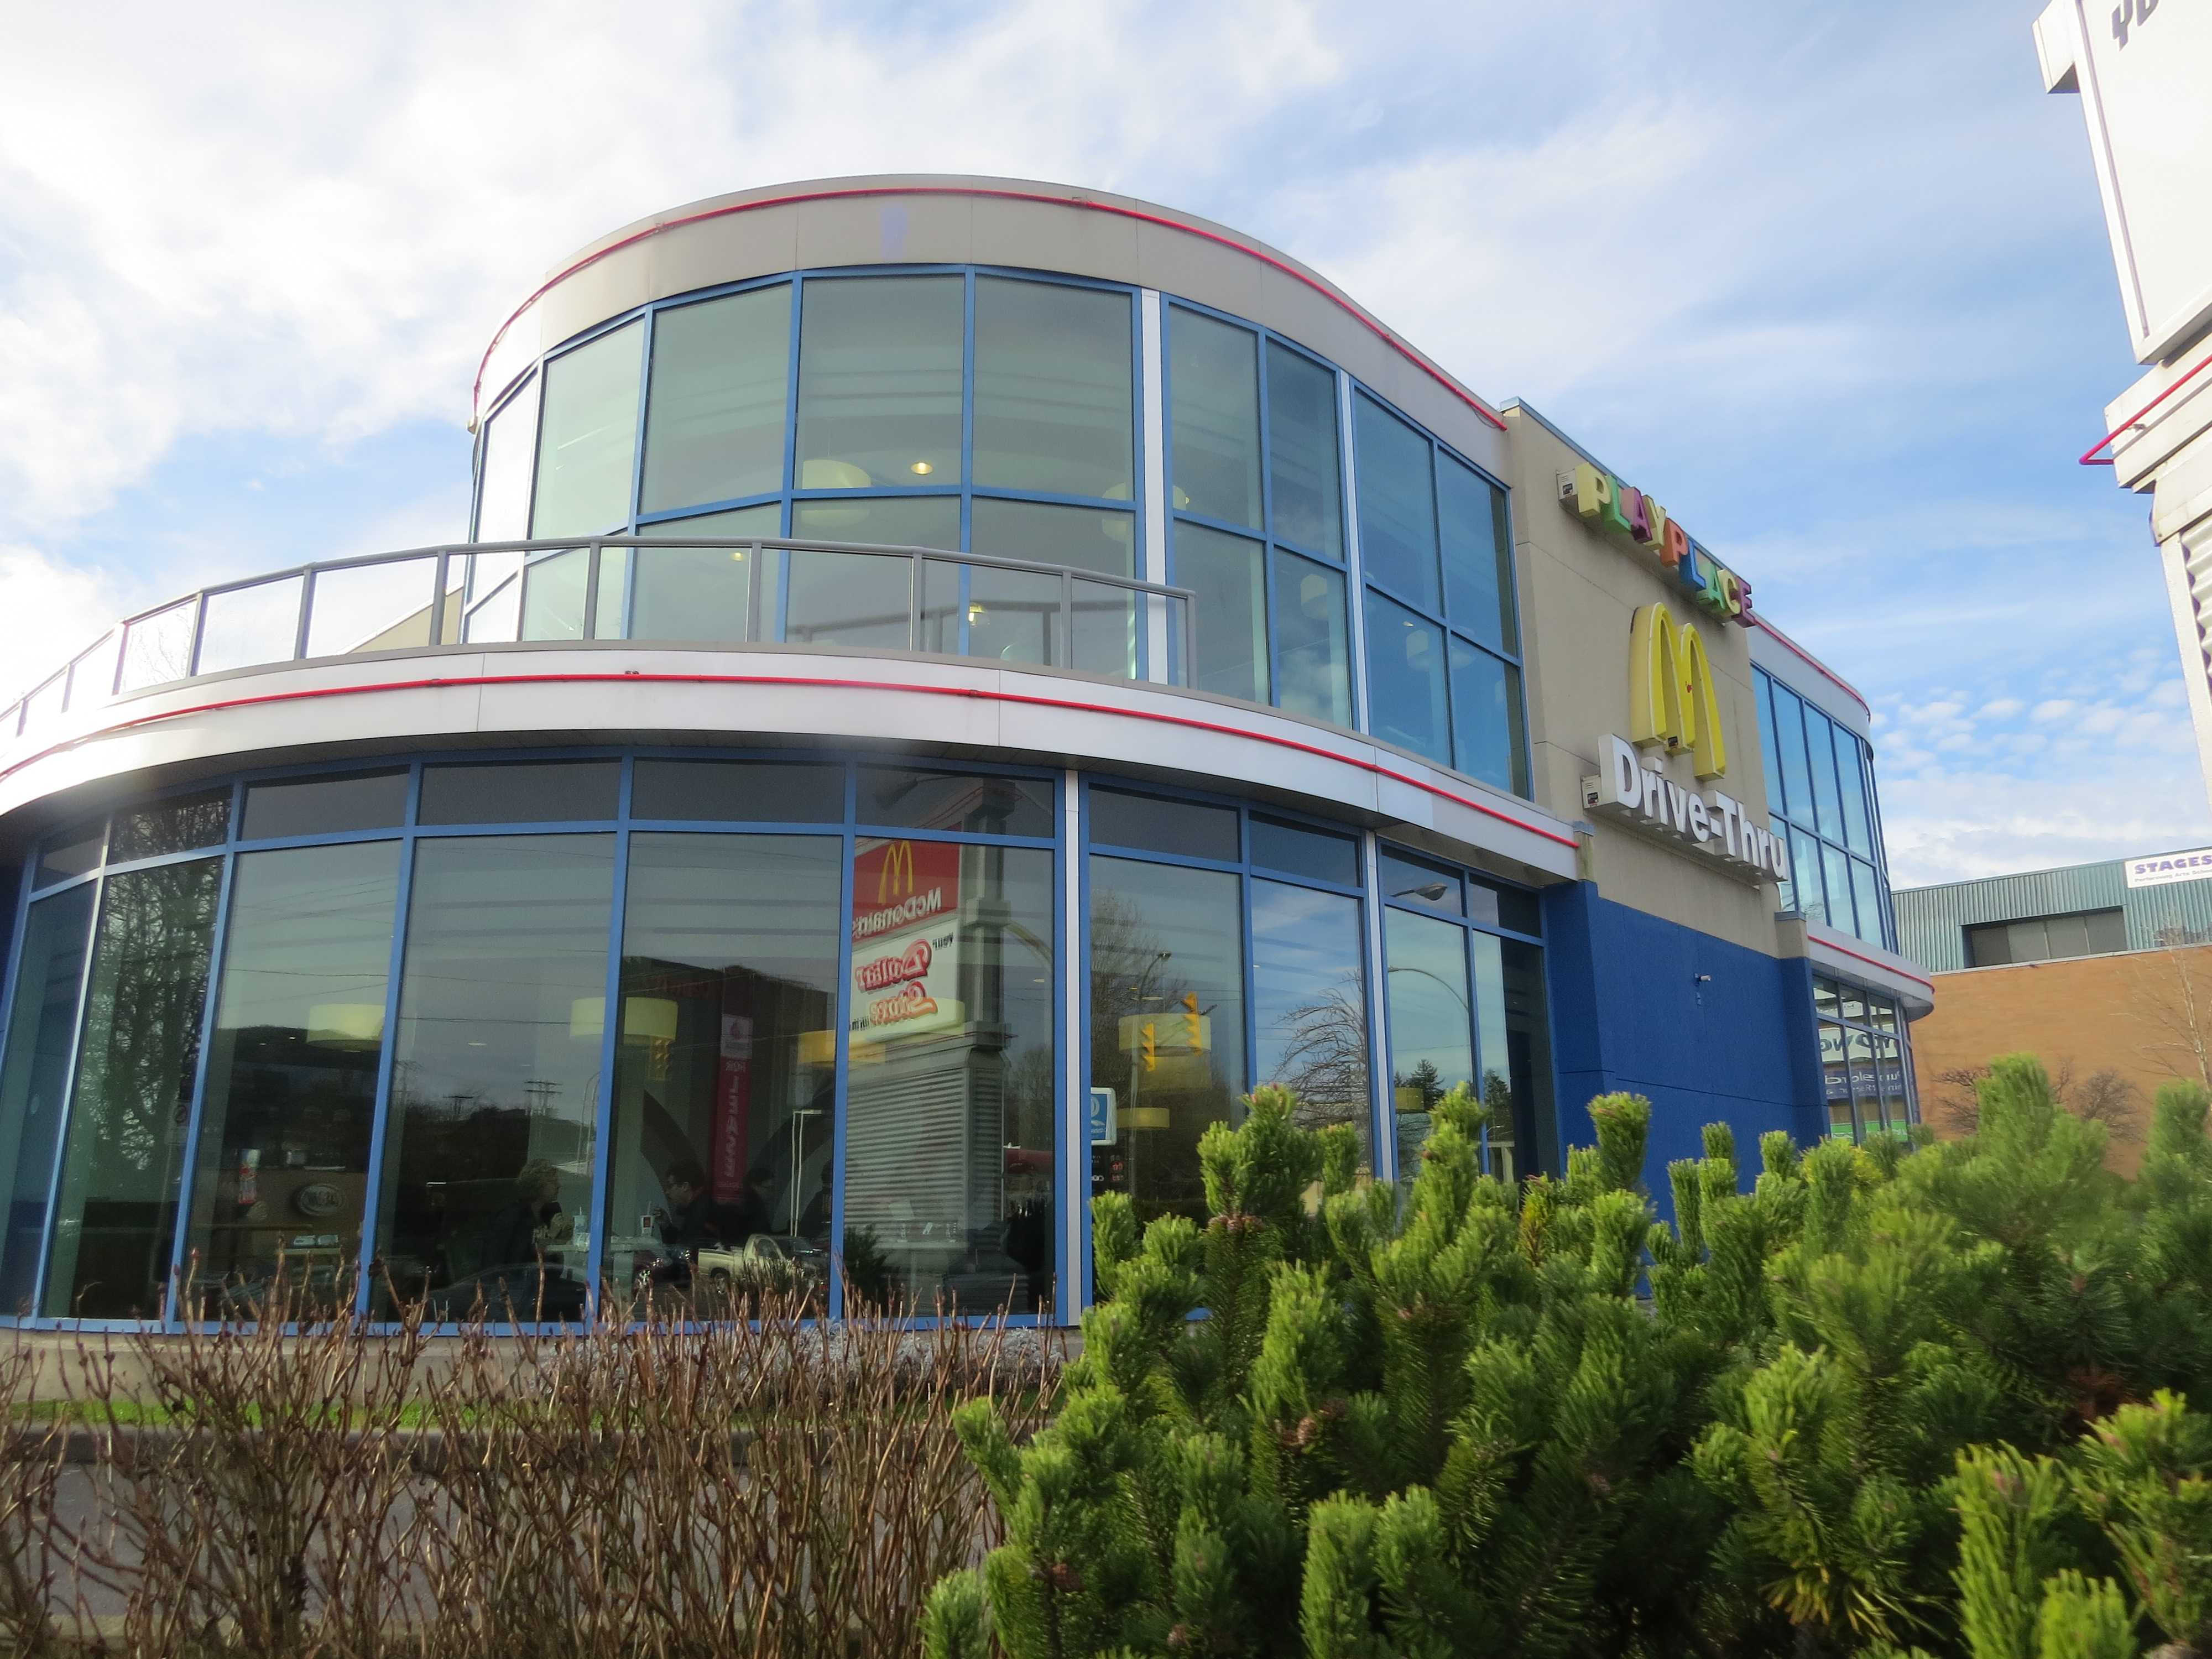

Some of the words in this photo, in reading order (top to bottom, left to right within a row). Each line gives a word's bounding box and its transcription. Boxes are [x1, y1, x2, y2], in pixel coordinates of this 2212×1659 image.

[1577, 462, 1755, 628] PLAYPLACE
[1598, 734, 1788, 883] Drive-Thru
[2134, 855, 2212, 874] STAGES
